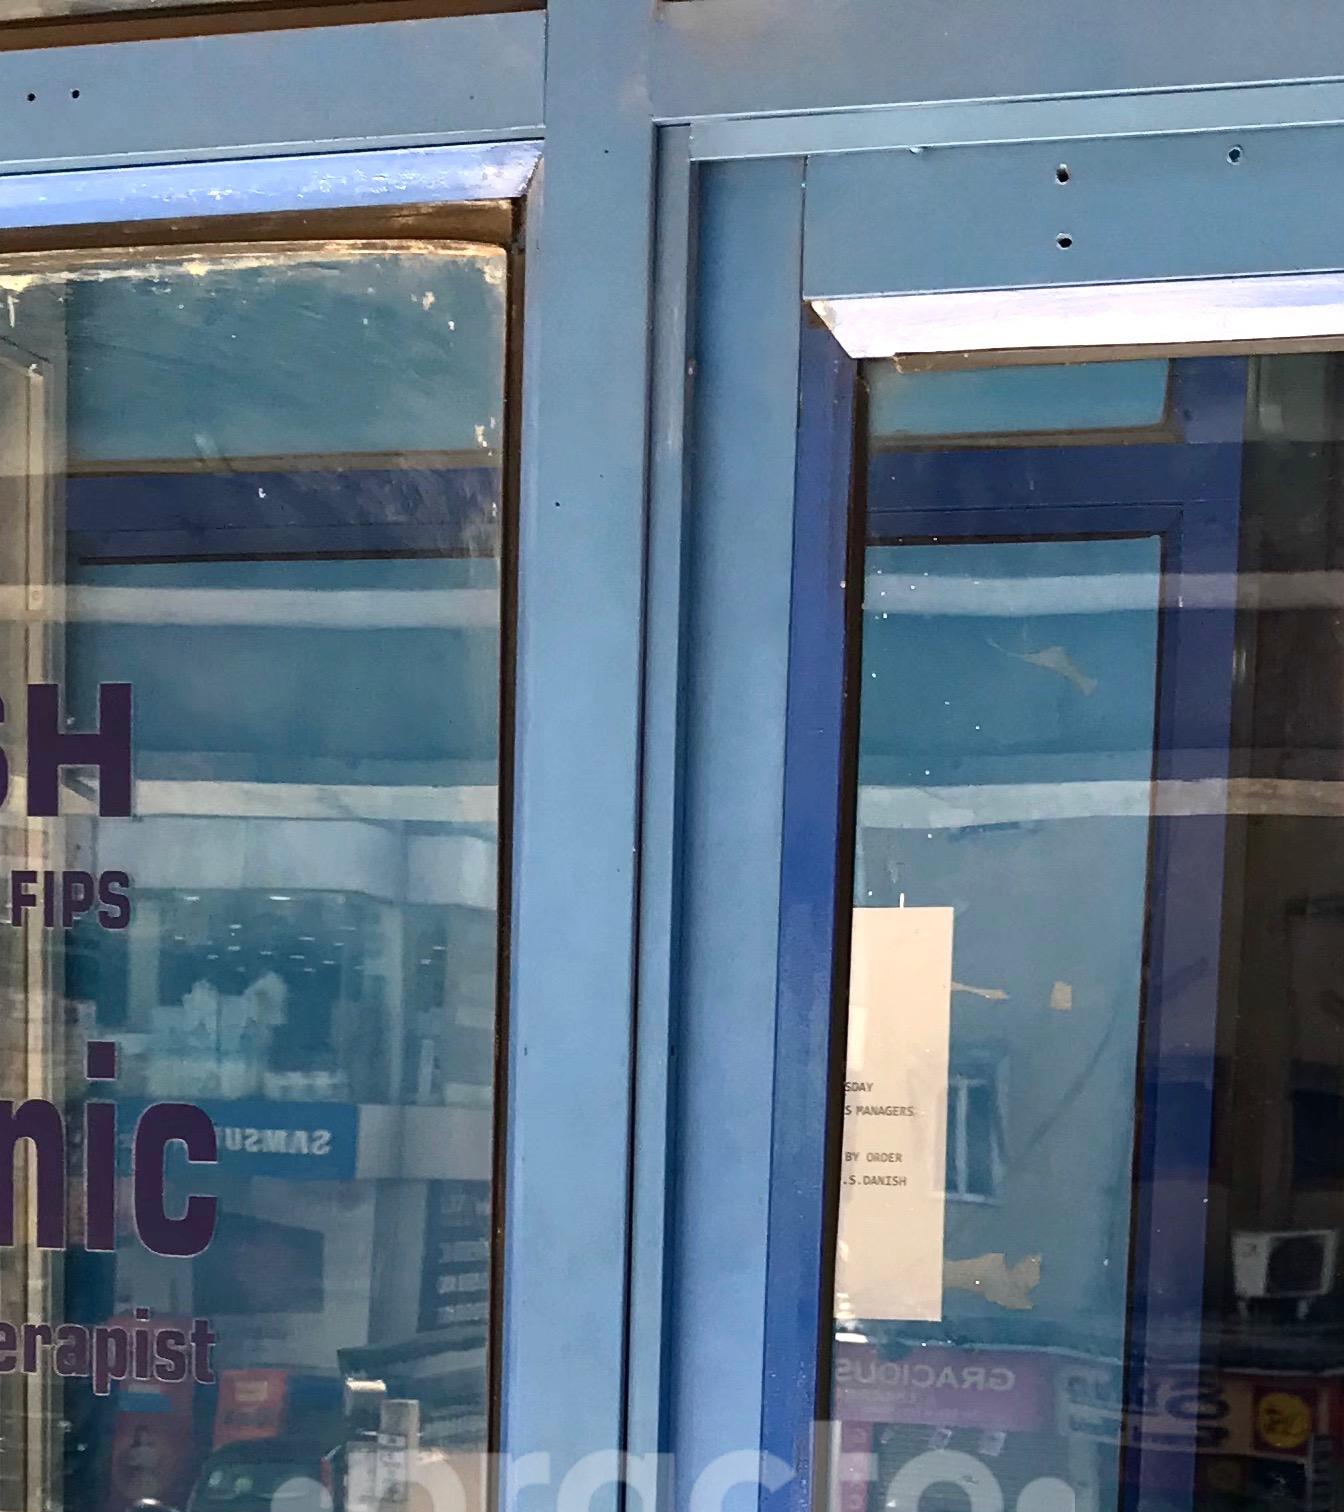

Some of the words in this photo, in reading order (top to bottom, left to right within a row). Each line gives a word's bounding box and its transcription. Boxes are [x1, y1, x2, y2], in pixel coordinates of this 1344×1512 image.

[10, 871, 133, 931] FIPS
[844, 1151, 860, 1161] BY
[866, 1152, 903, 1163] ORDER
